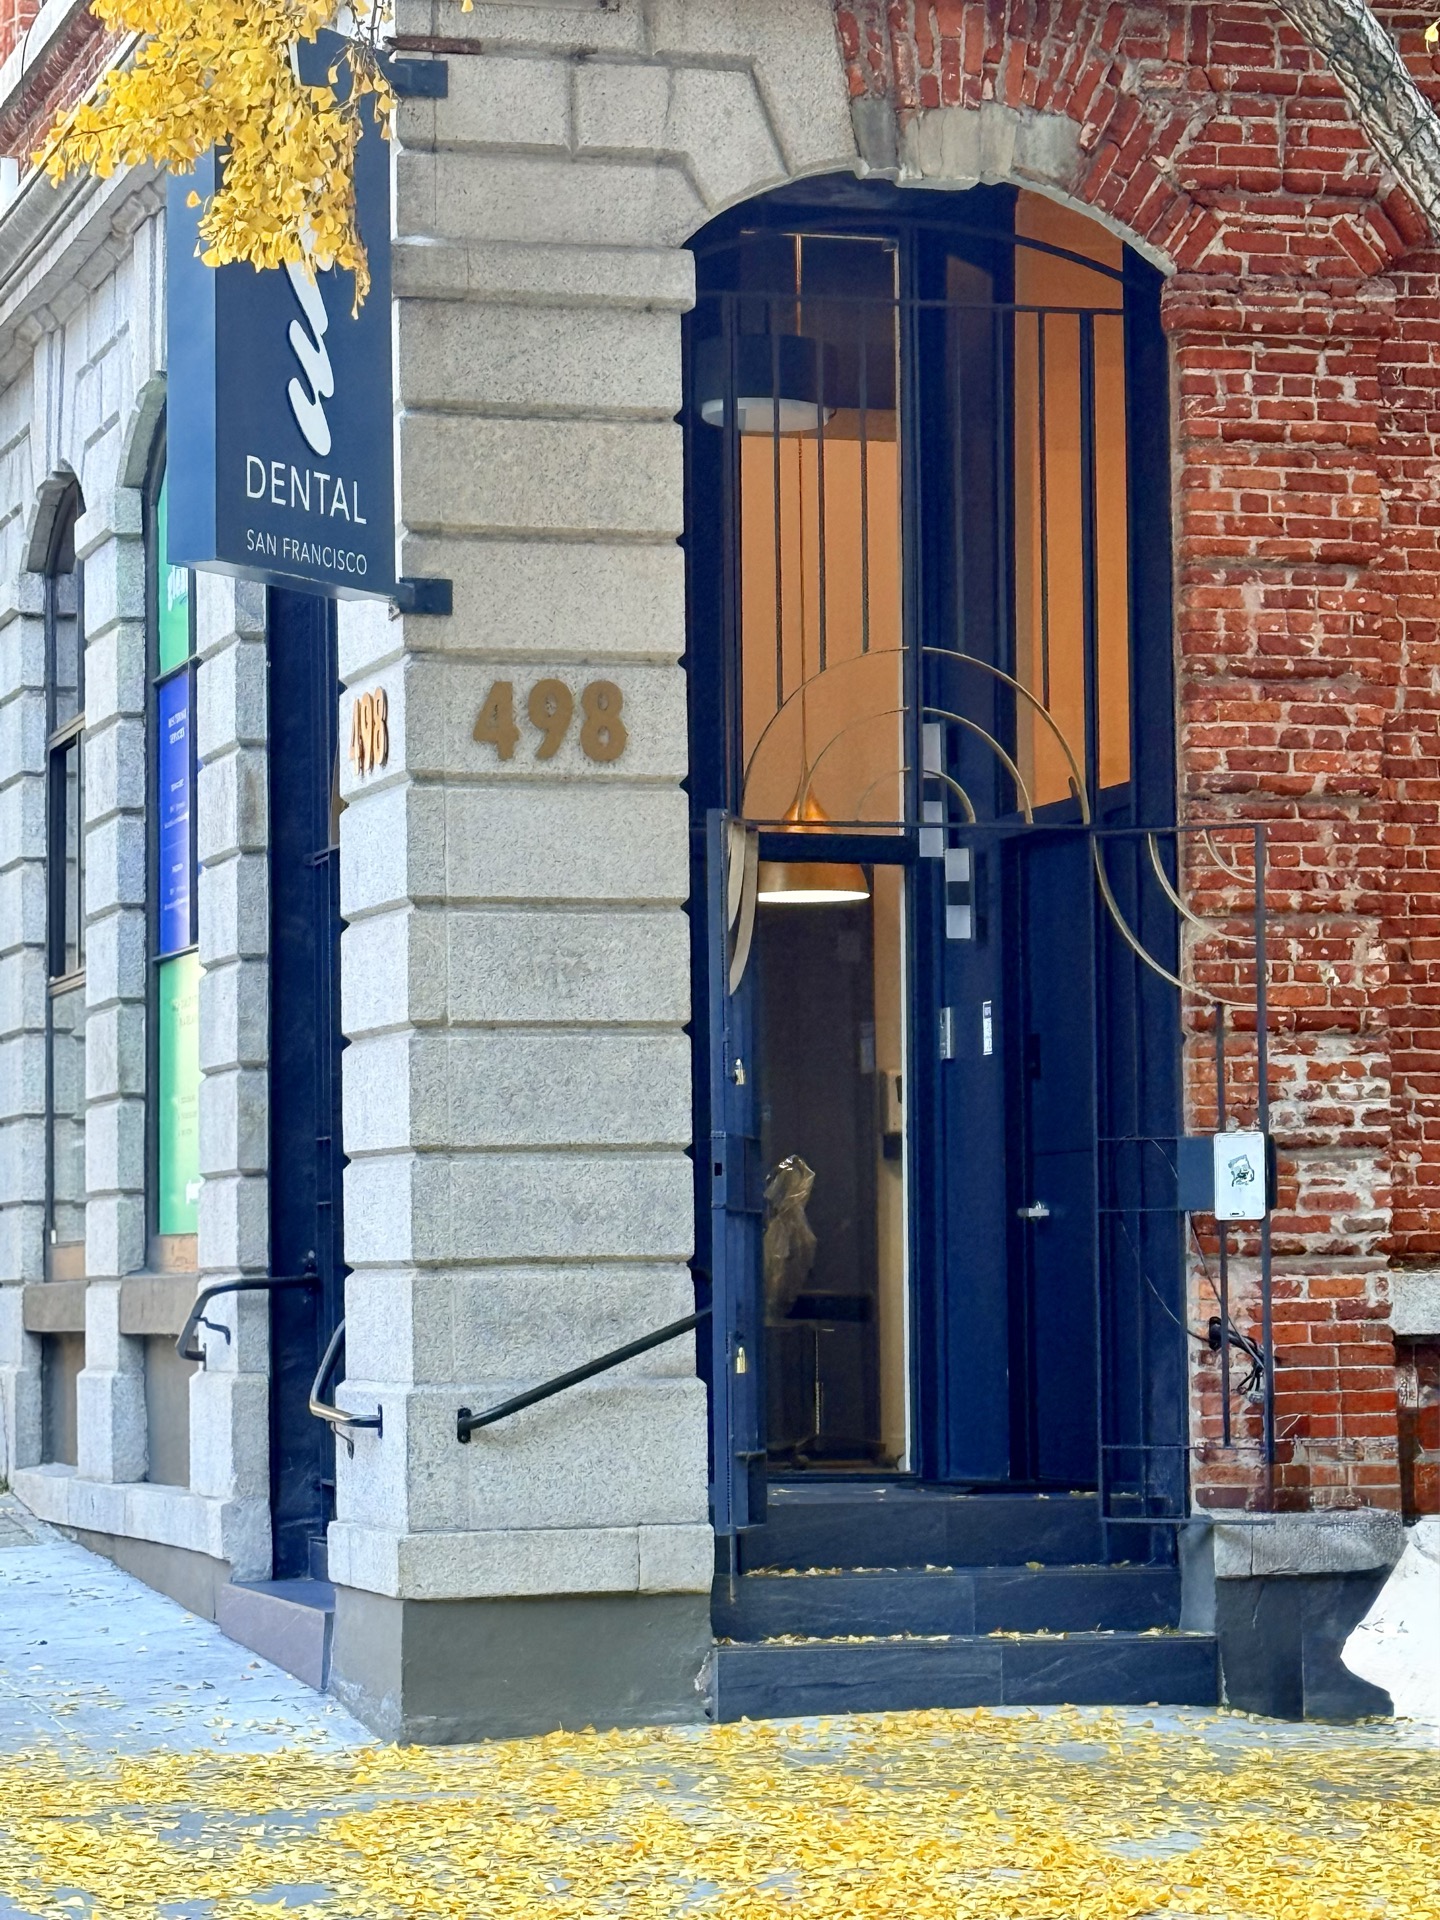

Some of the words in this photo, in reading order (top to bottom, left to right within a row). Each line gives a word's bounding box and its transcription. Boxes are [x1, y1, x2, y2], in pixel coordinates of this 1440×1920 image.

[246, 455, 367, 525] DENTAL
[246, 528, 277, 556] SAN
[282, 538, 368, 575] FRANCISCO
[349, 686, 389, 776] 498
[472, 678, 627, 763] 498
